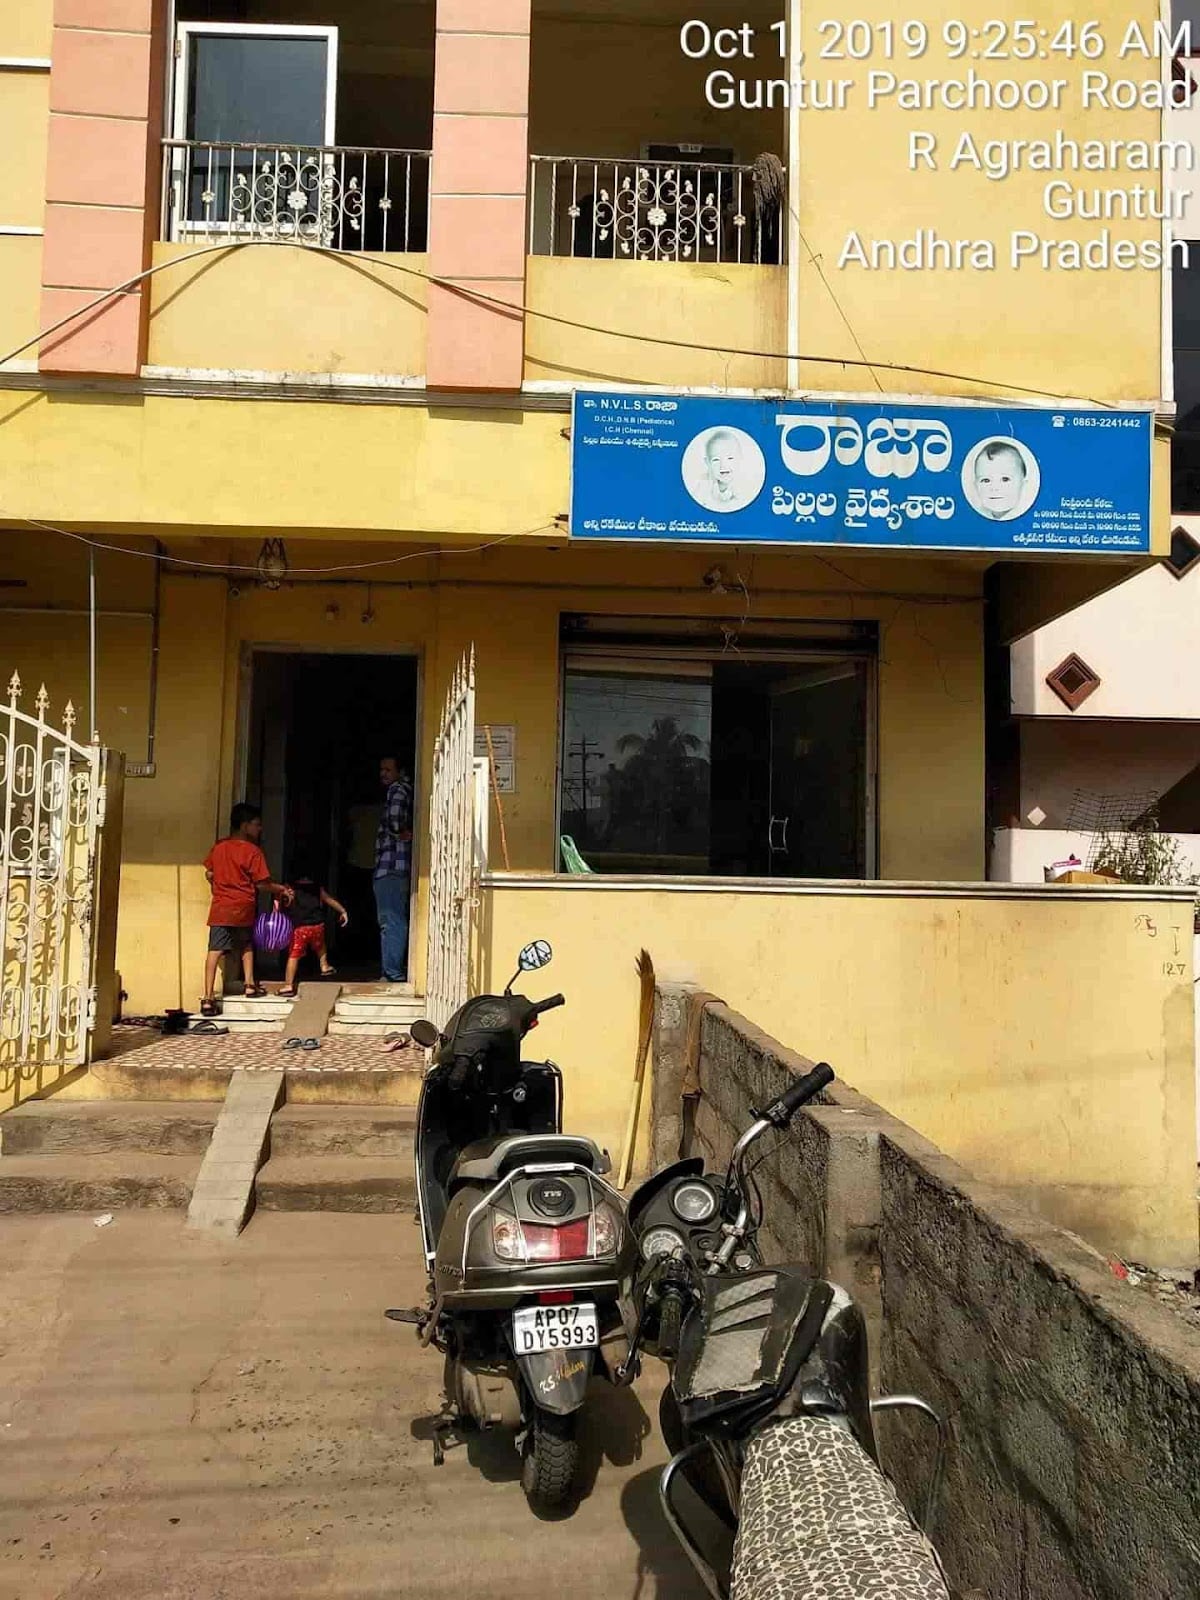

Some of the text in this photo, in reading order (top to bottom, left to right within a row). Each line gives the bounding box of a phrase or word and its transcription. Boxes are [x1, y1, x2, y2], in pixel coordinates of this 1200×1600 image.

[1072, 417, 1141, 428] 0863-2241442
[775, 414, 952, 478] రాజా
[772, 486, 955, 530] పిల్లల వైద్యశాల
[543, 1190, 562, 1198] TVS
[535, 1307, 579, 1328] AP07
[523, 1325, 596, 1350] DY5993
